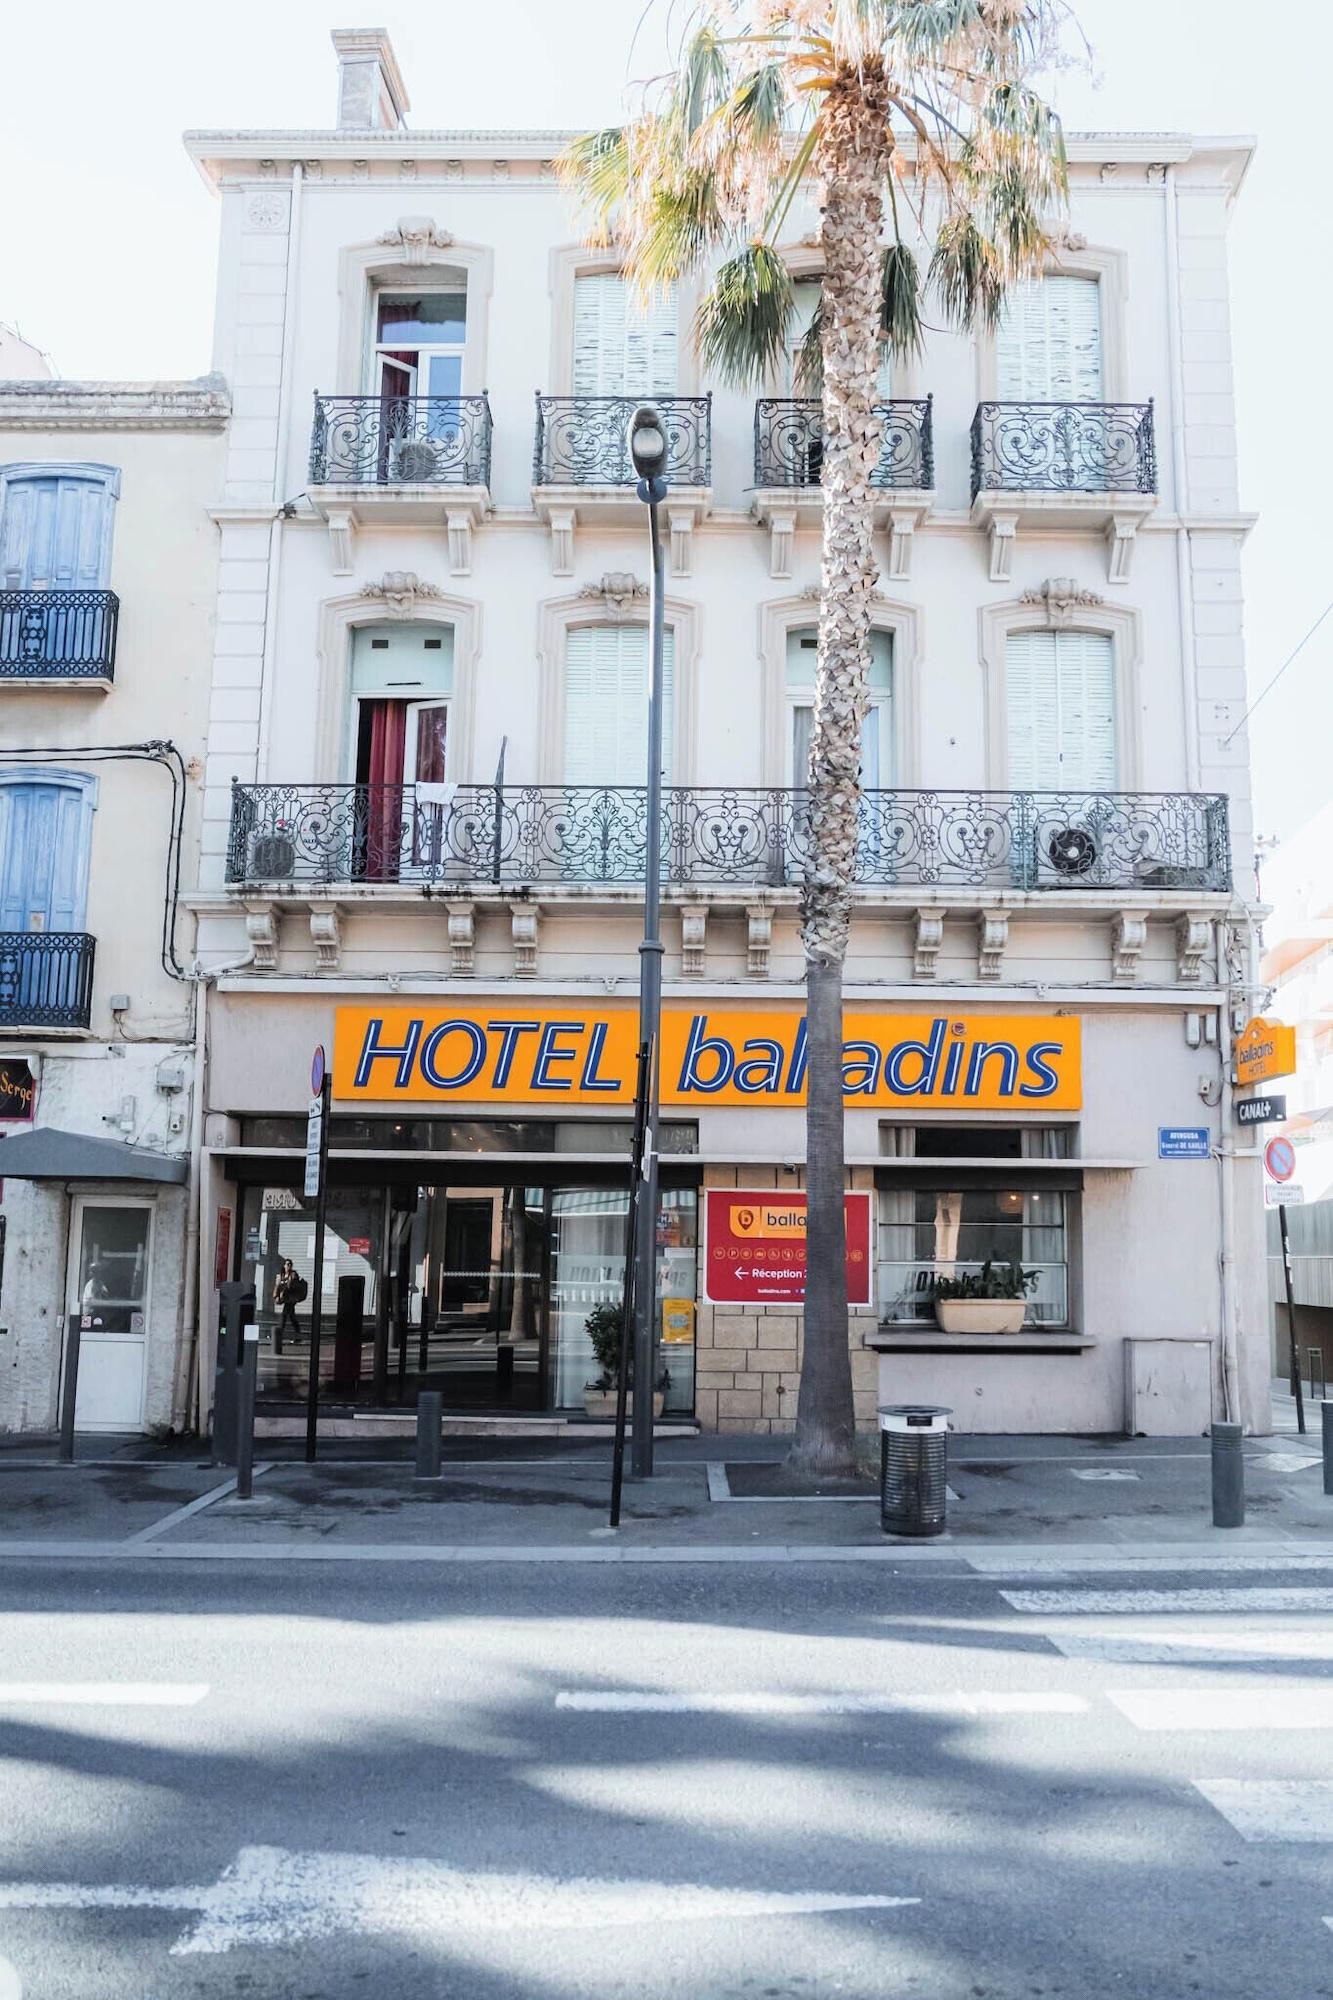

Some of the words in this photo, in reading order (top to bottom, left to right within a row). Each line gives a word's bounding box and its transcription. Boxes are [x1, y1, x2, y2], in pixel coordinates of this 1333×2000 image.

[353, 1019, 622, 1090] HOTEL
[677, 1015, 1063, 1097] baladins
[1240, 1041, 1274, 1064] balladins
[1248, 1060, 1266, 1075] HOTEL
[1240, 1101, 1271, 1120] CANAL+
[752, 1268, 802, 1280] Réception
